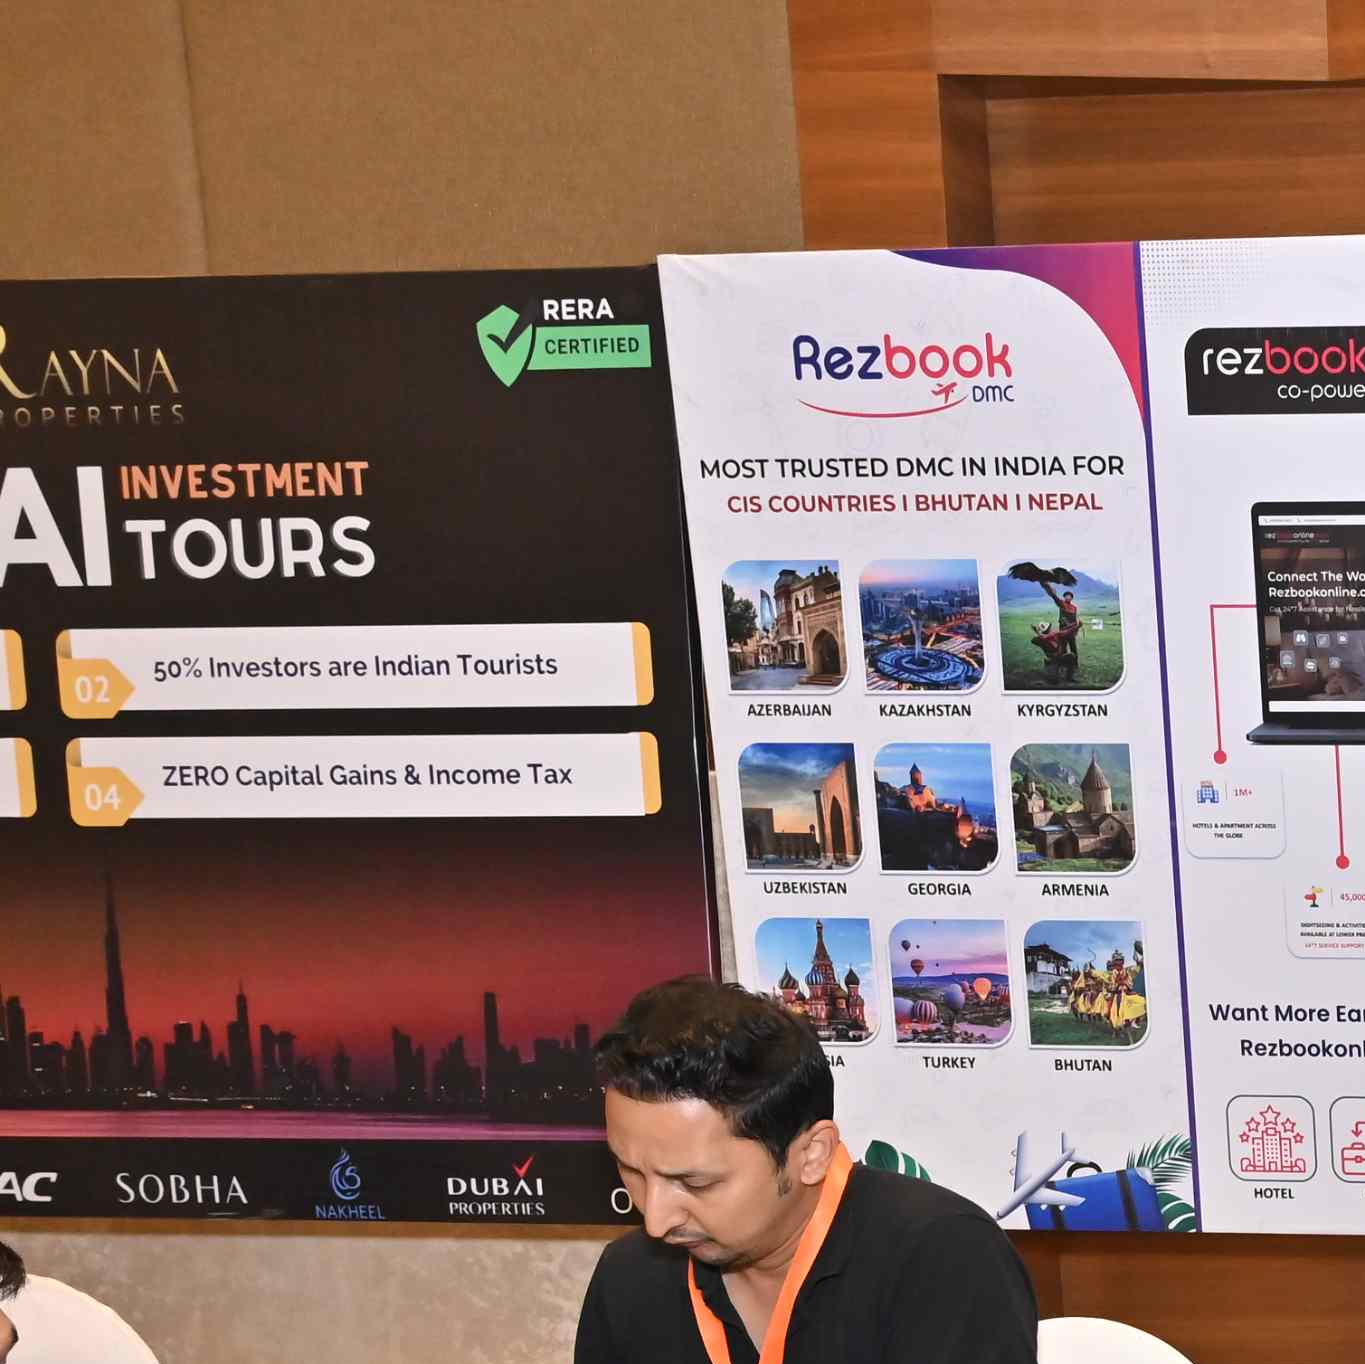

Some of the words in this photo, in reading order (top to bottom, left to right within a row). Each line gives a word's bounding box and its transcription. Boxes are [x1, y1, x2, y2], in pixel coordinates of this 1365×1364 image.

[543, 297, 614, 321] RERA
[544, 336, 640, 356] CERTIFIED
[793, 332, 1013, 382] Rezbook
[972, 384, 1015, 403] DMC
[700, 458, 769, 480] MOST
[775, 457, 888, 479] TRUSTED
[897, 456, 954, 478] DMC
[962, 456, 986, 476] IN
[994, 455, 1065, 476] INDIA
[1073, 455, 1125, 476] FOR
[120, 461, 369, 500] INVESTMENT
[727, 495, 763, 513] CIS
[769, 494, 896, 513] COUNTRIES
[915, 493, 1010, 512] BHUTAN
[1028, 493, 1104, 511] NEPAL
[123, 515, 376, 580] TOURS
[1267, 571, 1318, 582] Connect
[1321, 571, 1343, 582] The
[75, 675, 110, 703] 02
[153, 657, 203, 683] 50%
[208, 655, 323, 680] Investors
[327, 659, 368, 678] are
[374, 653, 451, 678] Indian
[457, 652, 558, 677] Tourists
[747, 703, 832, 718] AZERBAIJAN
[879, 703, 972, 718] KAZAKHSTAN
[1017, 703, 1109, 718] KYRGYZSTAN
[84, 784, 121, 811] 04
[161, 764, 230, 788] ZERO
[234, 763, 324, 792] Capital
[329, 763, 398, 787] Gains
[403, 765, 422, 787] &
[427, 763, 522, 786] Income
[526, 763, 574, 786] Tax
[763, 881, 847, 896] UZBEKISTAN
[907, 882, 972, 897] GEORGIA
[1041, 882, 1109, 897] ARMENIA
[1209, 1004, 1269, 1022] Want
[1274, 1005, 1330, 1024] More
[922, 1055, 976, 1071] TURKEY
[1054, 1058, 1112, 1073] BHUTAN
[116, 1172, 249, 1205] SOBHA
[447, 1177, 545, 1197] DUBAI
[1254, 1188, 1294, 1200] HOTEL
[315, 1205, 386, 1221] NAKHEEL
[448, 1201, 546, 1217] PROPERTIES
